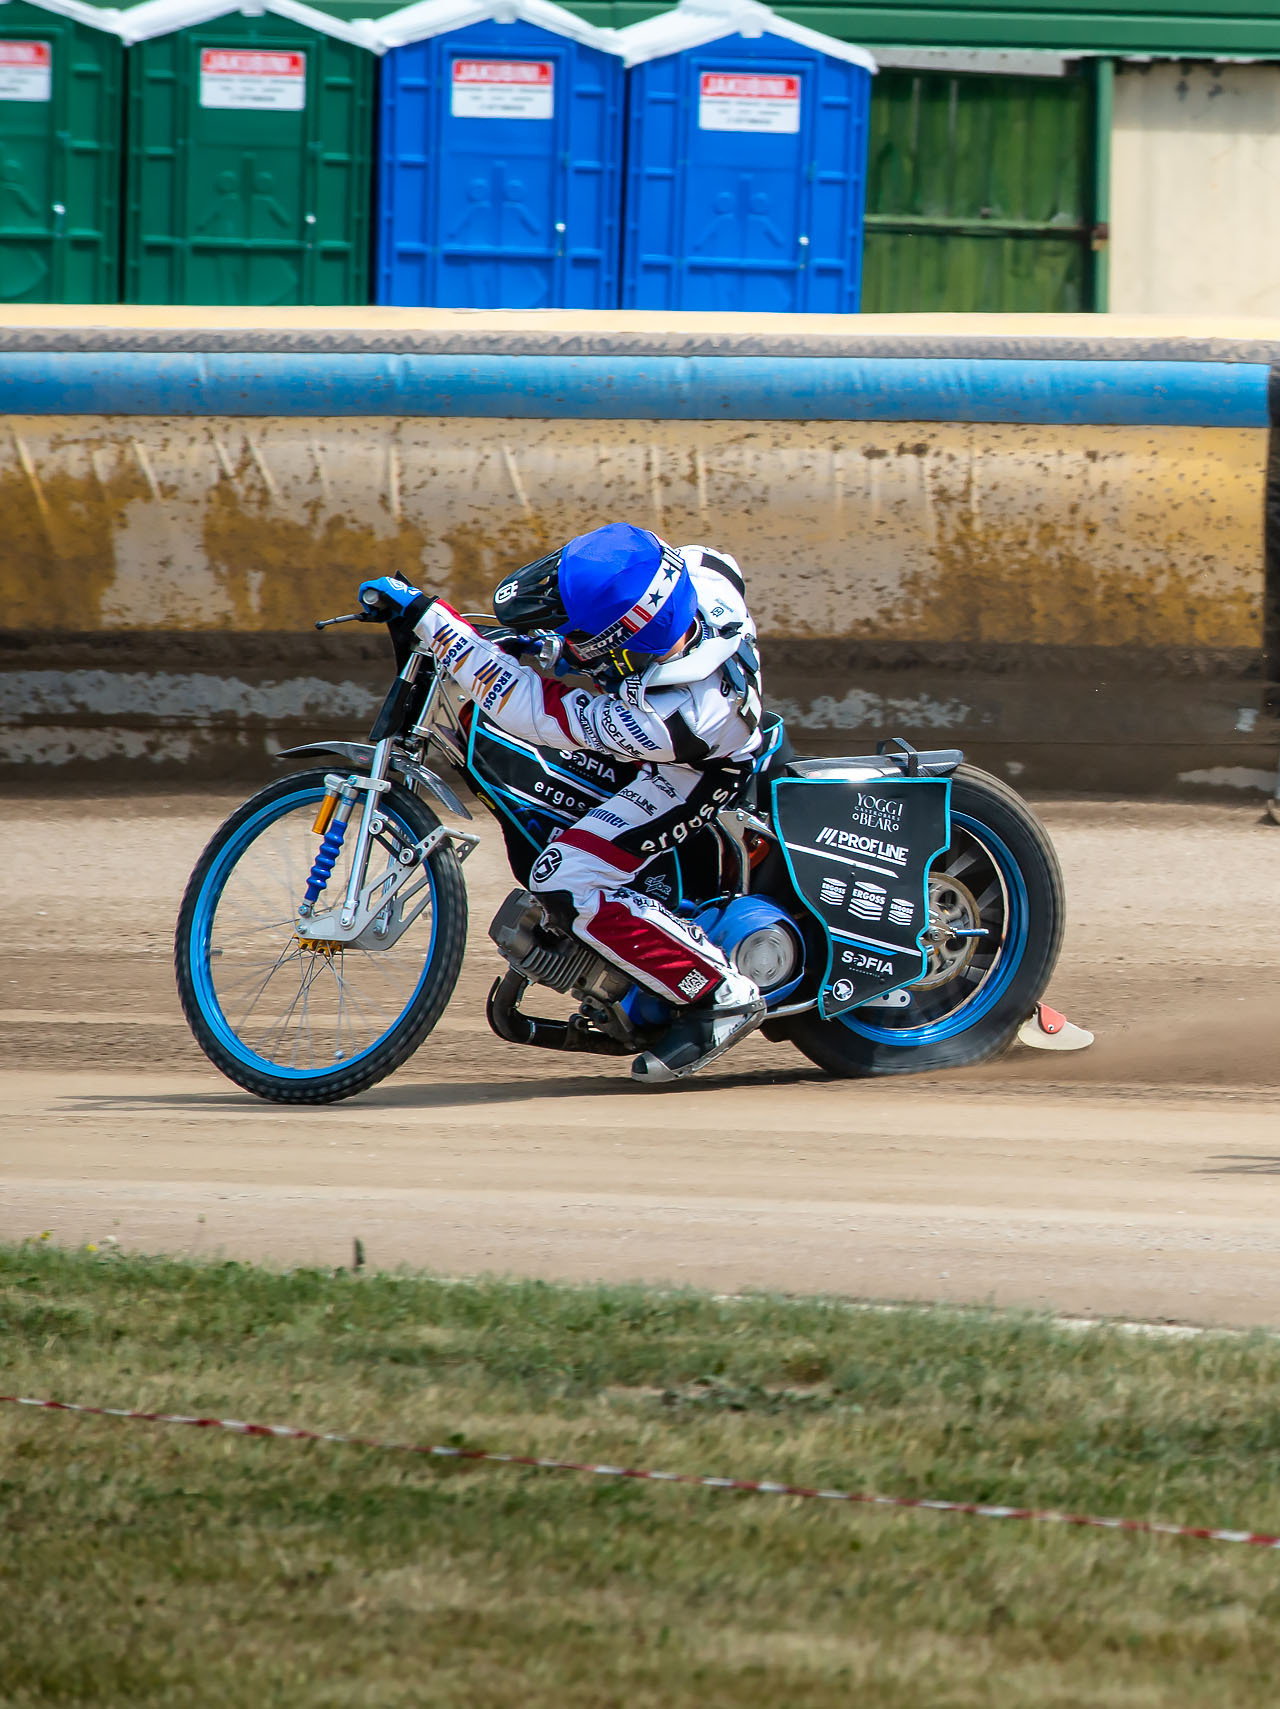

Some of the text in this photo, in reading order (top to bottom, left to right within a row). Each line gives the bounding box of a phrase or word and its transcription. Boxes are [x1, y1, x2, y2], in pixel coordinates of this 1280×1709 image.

[483, 670, 513, 711] ERGOSS
[619, 788, 658, 816] ROFLINE
[857, 792, 903, 816] YOGGI
[859, 812, 893, 833] BEAR
[852, 888, 886, 905] ERGOSS
[841, 950, 894, 975] SOFIA
